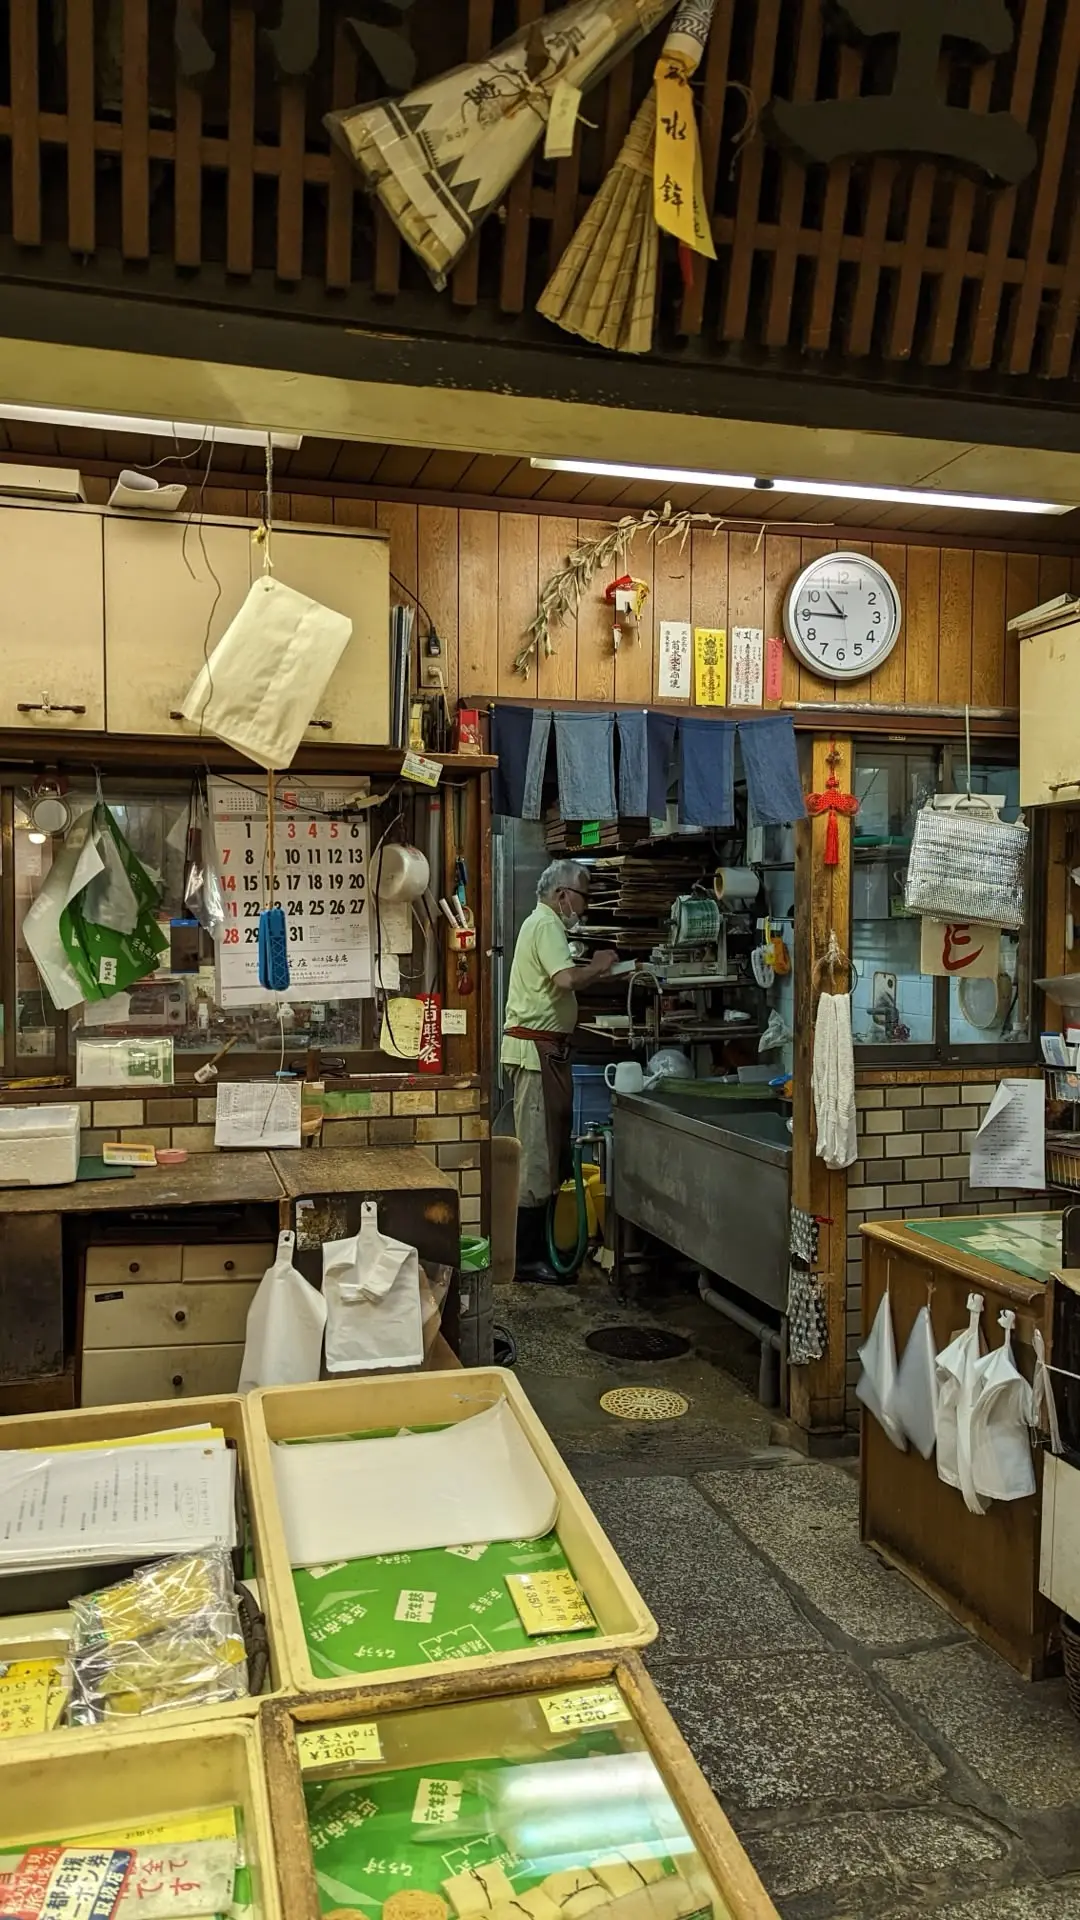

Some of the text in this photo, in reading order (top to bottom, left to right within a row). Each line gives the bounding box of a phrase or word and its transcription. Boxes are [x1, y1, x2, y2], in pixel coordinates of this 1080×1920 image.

[821, 577, 831, 589] 11
[837, 572, 850, 585] 12
[857, 578, 863, 591] 1
[807, 591, 821, 602] 10
[867, 592, 877, 605] 2
[802, 608, 811, 621] 9
[872, 611, 882, 625] 3
[807, 628, 816, 641] 8
[866, 630, 876, 643] 4
[819, 643, 829, 656] 7
[835, 648, 846, 661] 6
[853, 643, 863, 656] 5
[283, 792, 297, 810] 5
[245, 823, 360, 838] 1 3 4 5 6
[222, 850, 231, 864] 7
[245, 850, 254, 864] 8
[286, 850, 301, 864] 10
[308, 849, 321, 864] 11
[328, 849, 343, 864] 12
[349, 849, 363, 863] 13
[221, 874, 365, 891] 14 15 16 17 18 19 20
[244, 902, 261, 917] 22
[288, 901, 304, 916] 24
[309, 900, 325, 915] 25
[330, 900, 346, 915] 26
[350, 899, 365, 914] 27
[223, 929, 239, 944] 28
[245, 928, 260, 943] 29
[290, 926, 304, 941] 31
[93, 1870, 125, 1917] 取扱店
